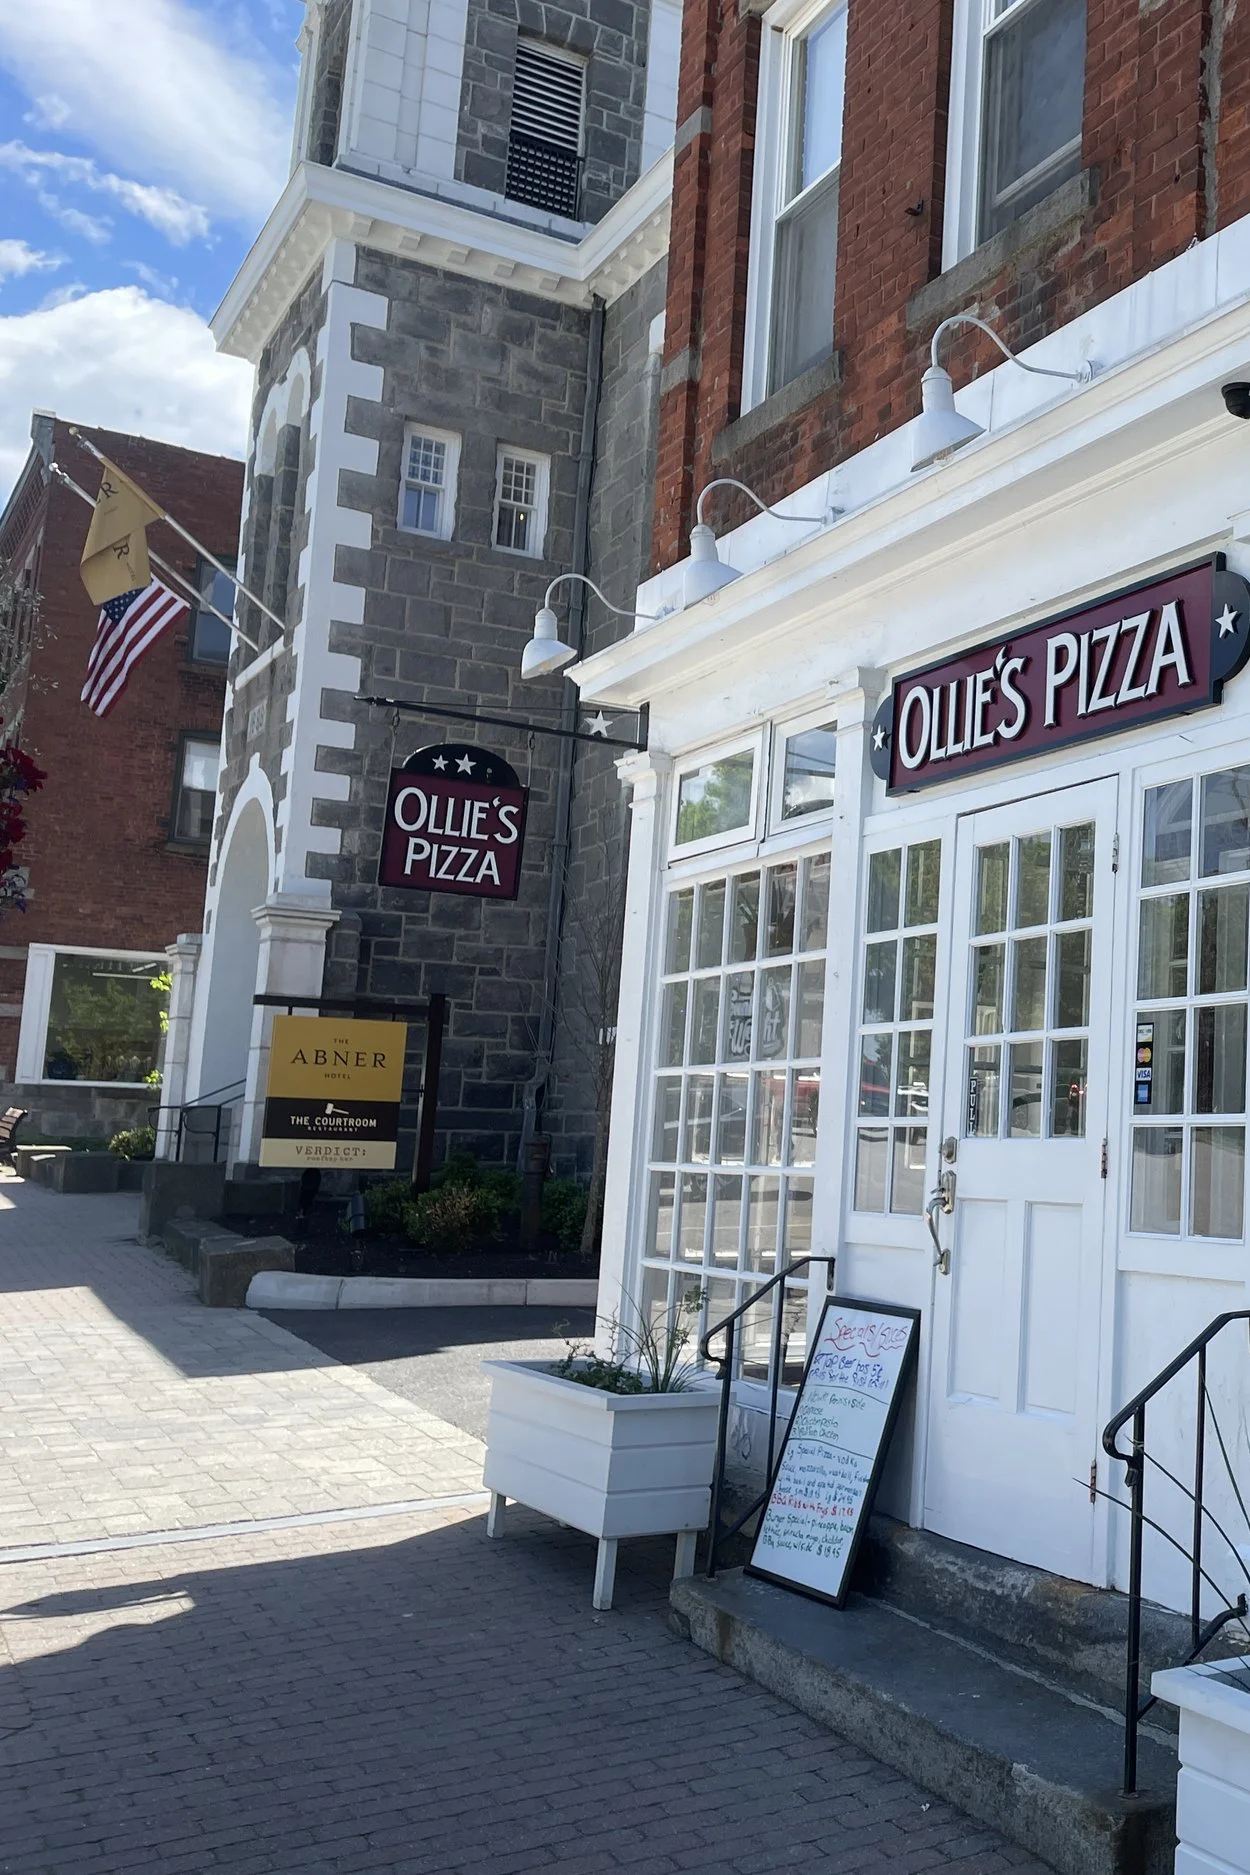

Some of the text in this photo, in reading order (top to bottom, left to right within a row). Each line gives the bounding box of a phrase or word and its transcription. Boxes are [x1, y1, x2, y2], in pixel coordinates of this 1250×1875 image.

[898, 601, 1192, 770] OLLIE'S PIZZA
[394, 786, 519, 845] OLLIE'S
[403, 836, 500, 886] PIZZA
[291, 1048, 387, 1069] ABNER
[324, 1072, 351, 1080] HOTEL
[1137, 1070, 1151, 1079] VISA
[290, 1115, 377, 1128] THE COURTROOM
[968, 1080, 977, 1137] PULL
